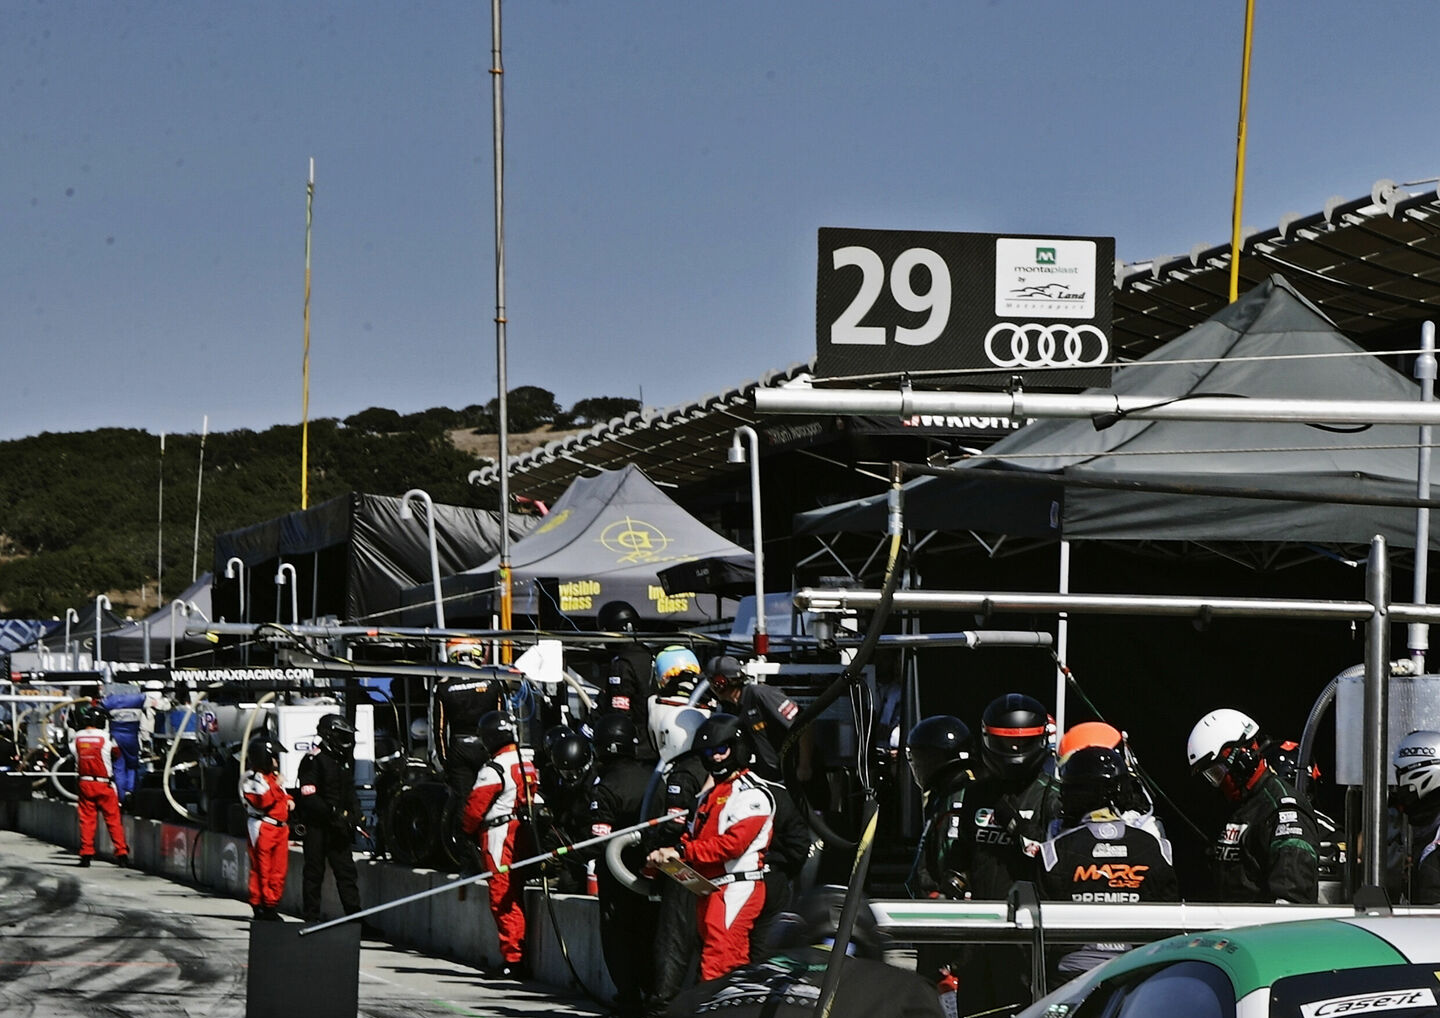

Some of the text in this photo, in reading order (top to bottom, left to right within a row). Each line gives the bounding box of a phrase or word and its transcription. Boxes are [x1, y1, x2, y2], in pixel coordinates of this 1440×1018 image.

[830, 245, 952, 346] 29
[1057, 291, 1086, 300] Land
[560, 594, 593, 612] Glass
[657, 597, 689, 613] Glass
[170, 668, 315, 682] WWW.KPAXRACING.COM
[975, 828, 1014, 846] EDG
[1073, 864, 1150, 883] MARC
[1108, 880, 1142, 889] CARS
